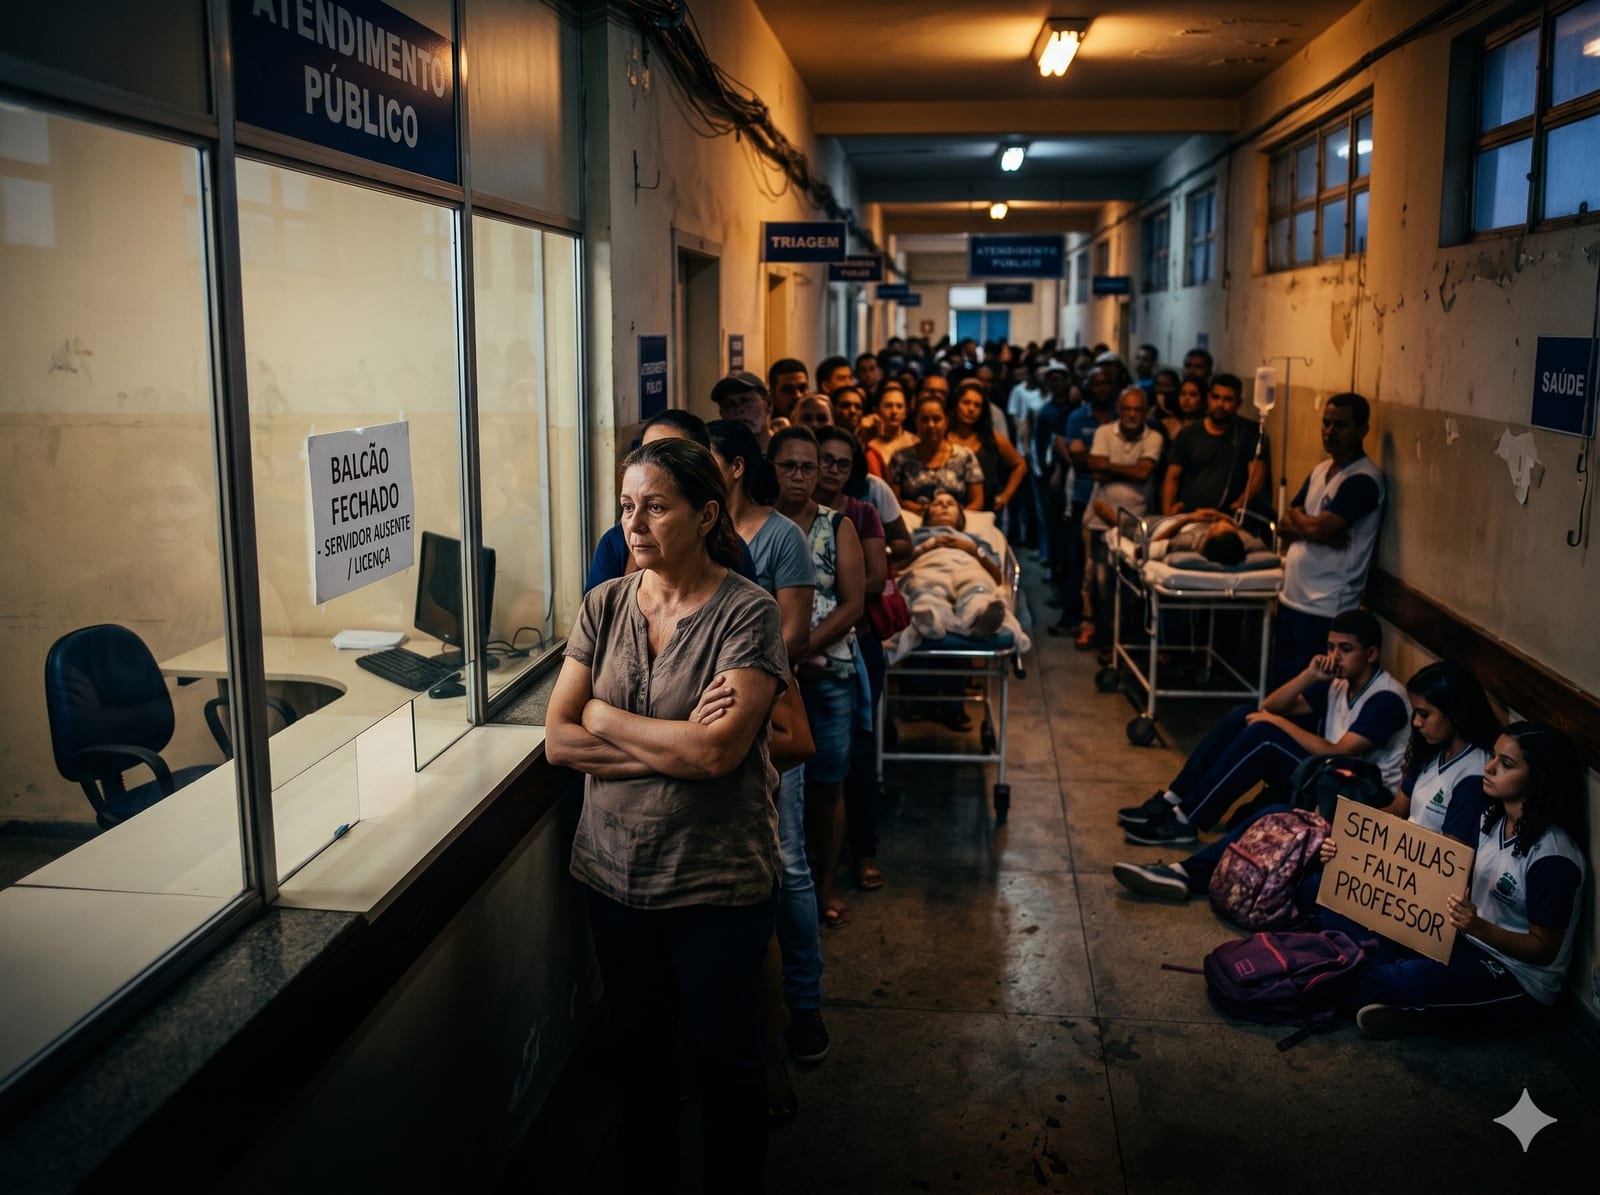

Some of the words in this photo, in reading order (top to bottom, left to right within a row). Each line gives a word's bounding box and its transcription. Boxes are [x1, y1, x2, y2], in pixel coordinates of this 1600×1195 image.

[304, 64, 419, 149] PÚBLICO
[771, 236, 840, 249] TRIAGEM
[1542, 367, 1585, 396] SAÚDE
[331, 442, 388, 484] BALCÃO
[331, 483, 399, 525] FECHADO
[325, 526, 372, 557] SERVIDOR
[373, 514, 411, 541] AUSENTE
[354, 547, 391, 574] LICENÇA
[1344, 812, 1389, 851] SEM
[1393, 833, 1456, 878] AULAS
[1363, 853, 1417, 896] FALTA
[1334, 870, 1445, 943] PROFESSOR
